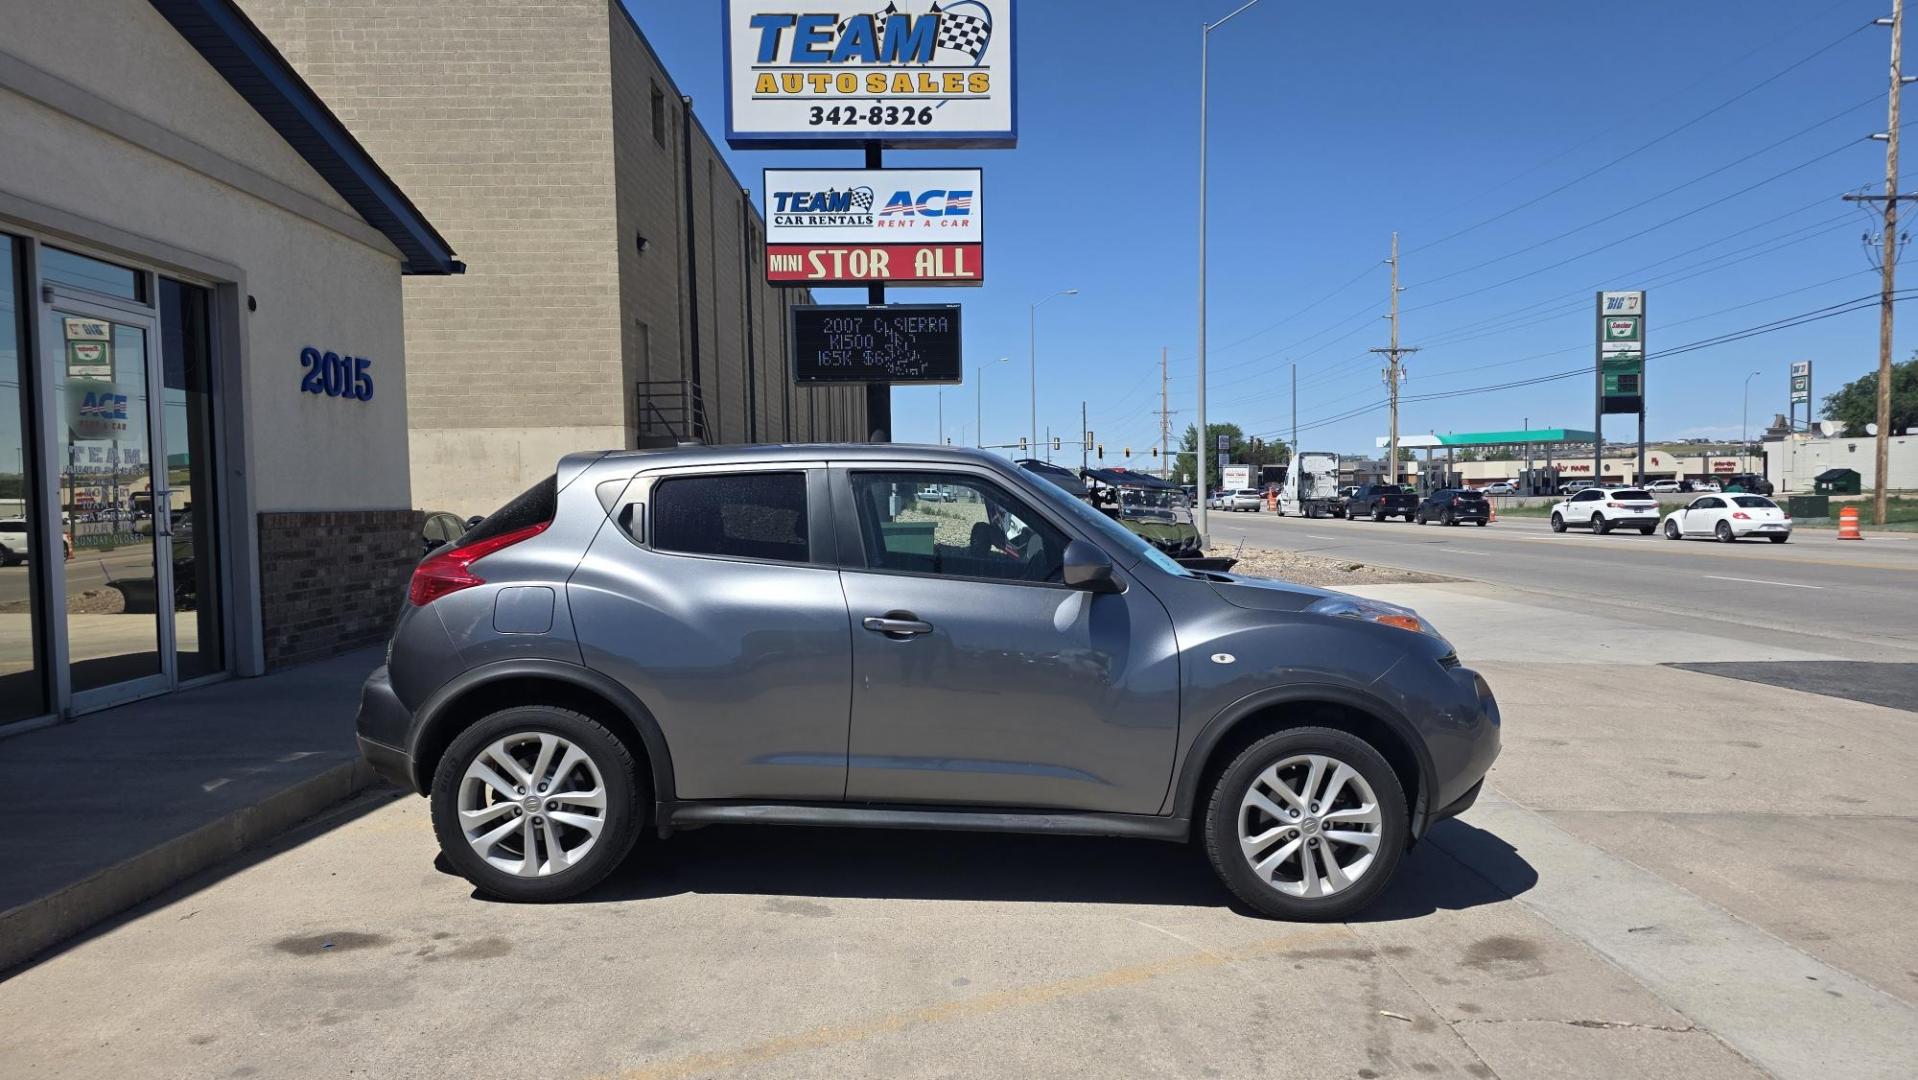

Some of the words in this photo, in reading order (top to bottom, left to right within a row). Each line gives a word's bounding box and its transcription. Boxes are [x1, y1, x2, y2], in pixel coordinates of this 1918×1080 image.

[750, 13, 942, 63] TEAM
[755, 73, 858, 93] AUTO
[865, 73, 990, 93] SALES
[808, 106, 933, 126] 342-8326
[773, 191, 850, 213] TEAM
[878, 189, 974, 217] ACE
[774, 216, 802, 225] CAR
[809, 216, 873, 225] RENTALS
[877, 219, 915, 228] RENT
[923, 219, 931, 228] A
[940, 219, 970, 228] CAR
[770, 254, 802, 272] MINI
[808, 248, 890, 278] STOR
[914, 248, 974, 277] ALL
[823, 317, 863, 333] 2007
[894, 317, 948, 333] SIERRA
[300, 347, 374, 401] 2015
[80, 391, 128, 419] ACE
[69, 446, 140, 464] TEAM
